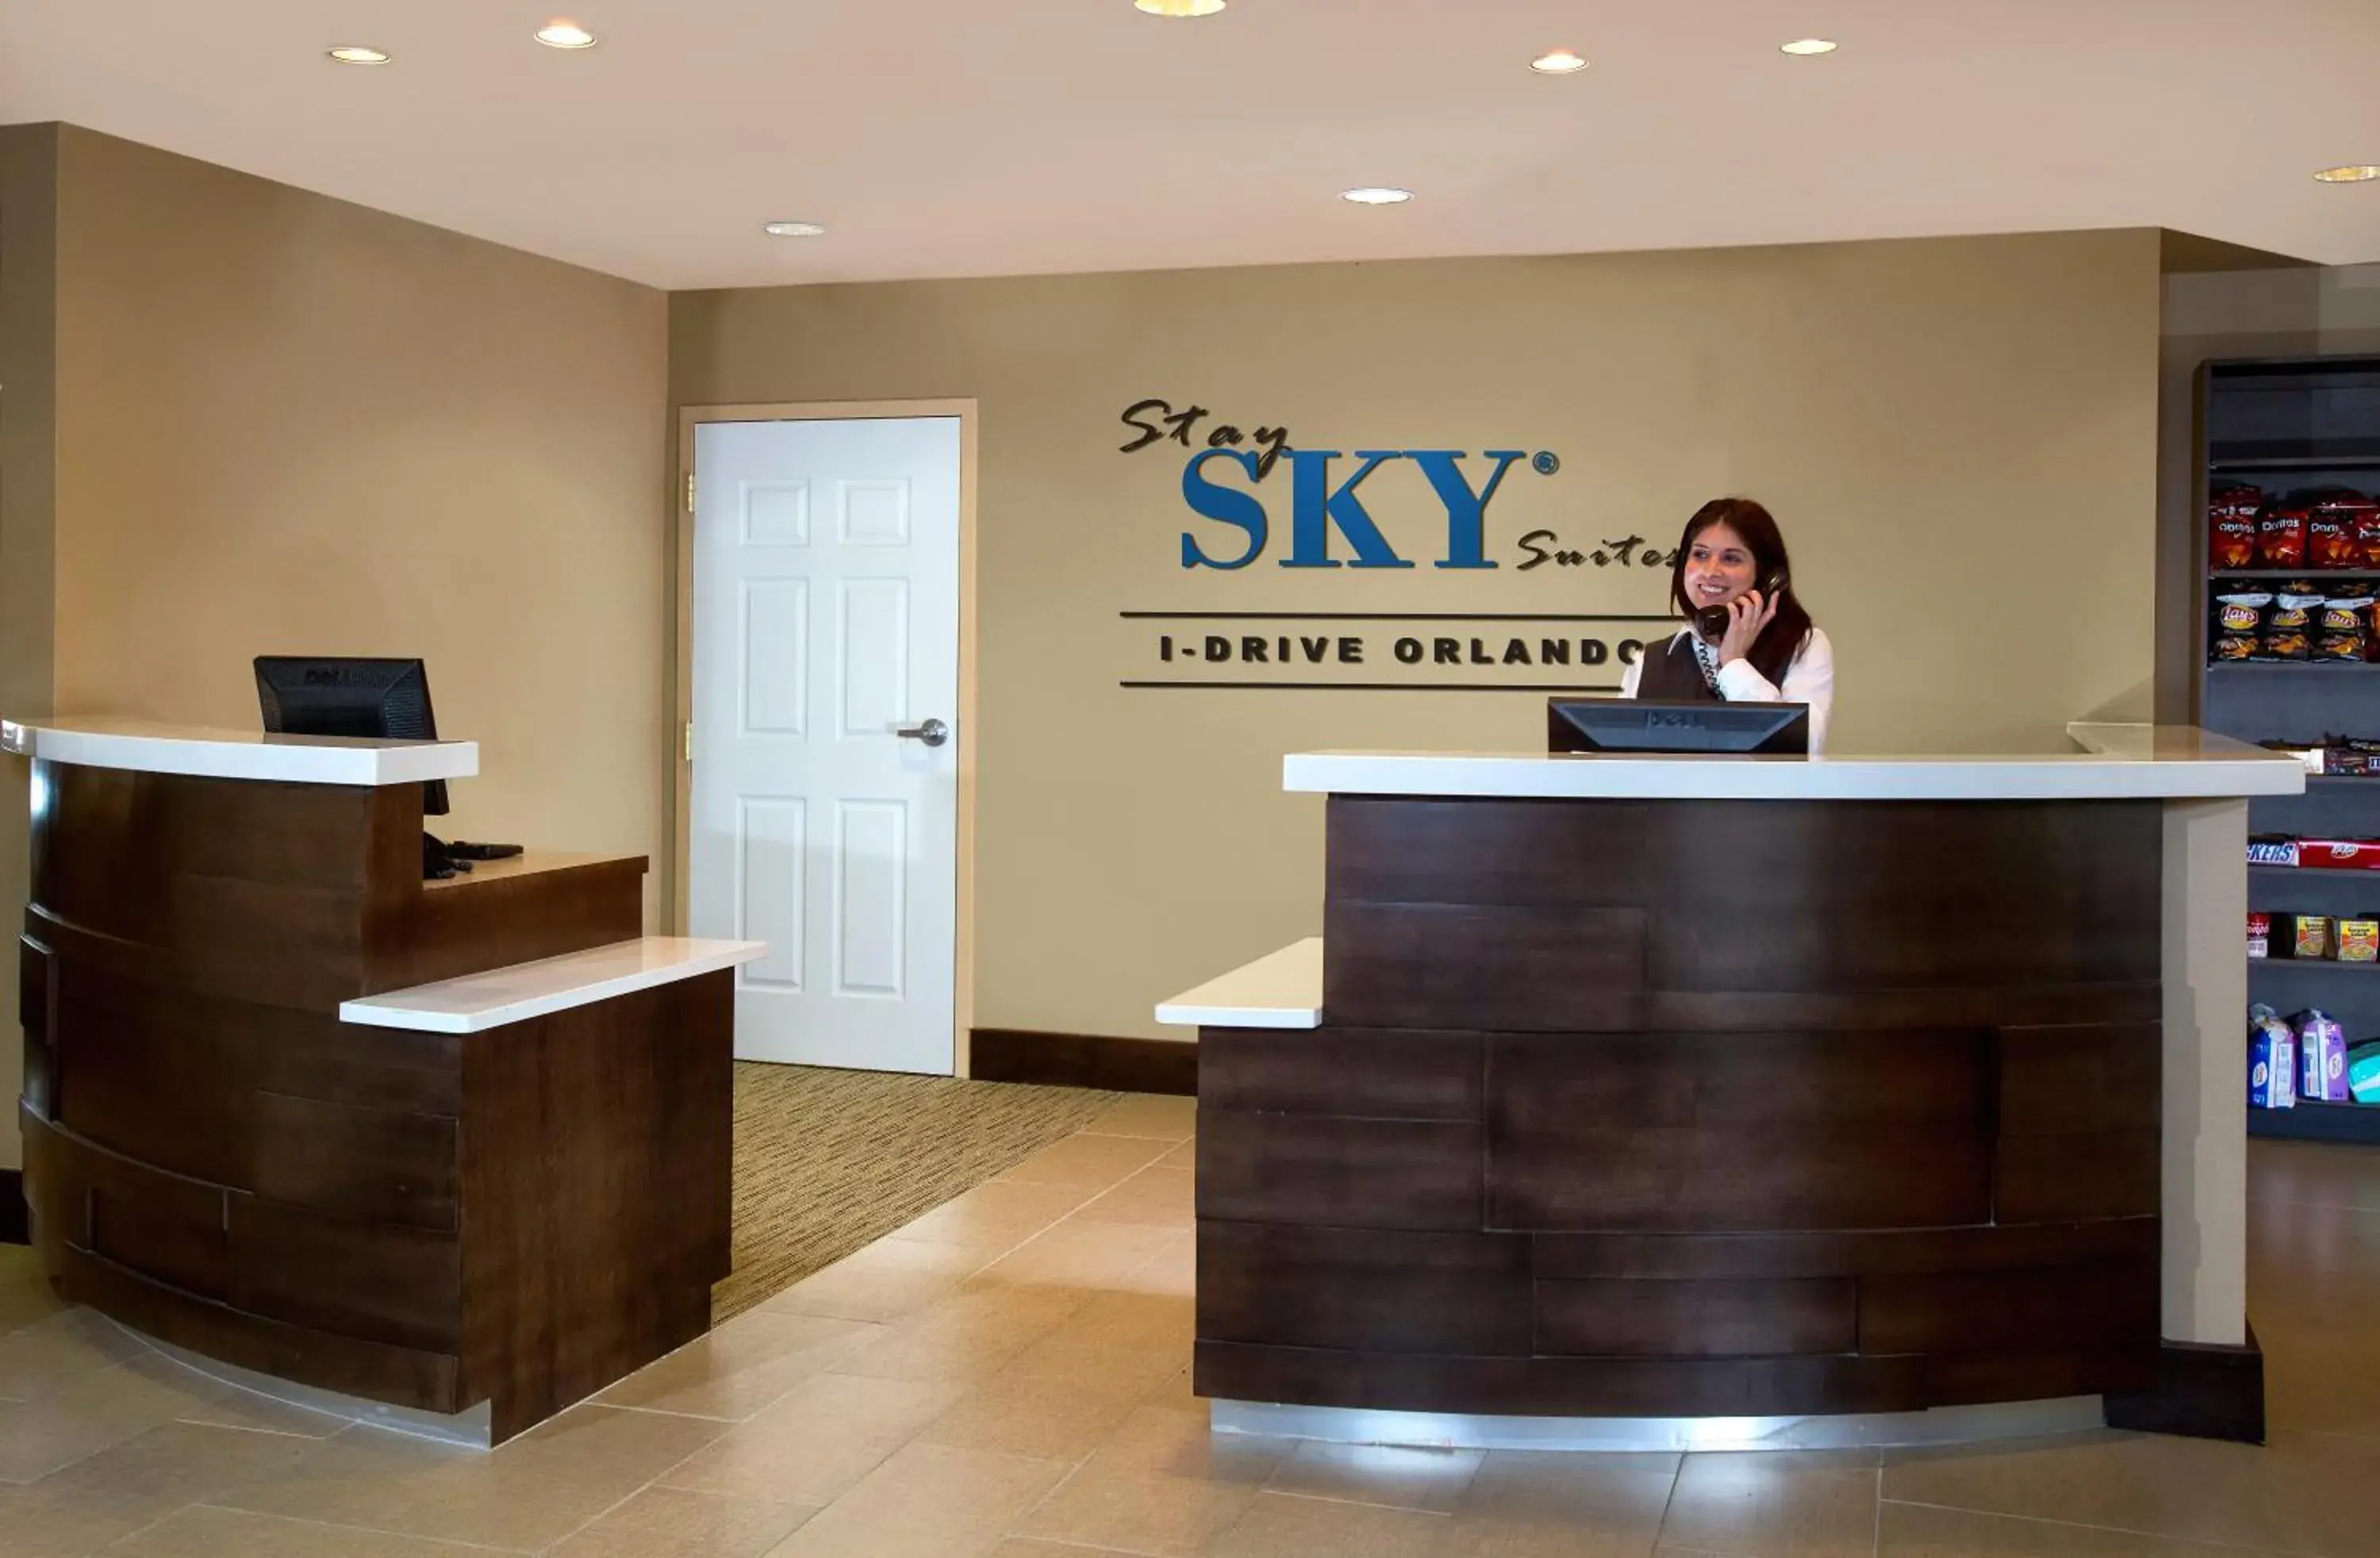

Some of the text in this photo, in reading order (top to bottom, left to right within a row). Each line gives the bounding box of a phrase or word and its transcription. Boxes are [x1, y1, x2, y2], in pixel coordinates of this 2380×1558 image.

[1119, 398, 1292, 483] Stay
[1161, 635, 1365, 663] I-DRIVE
[2247, 842, 2293, 862] KERS
